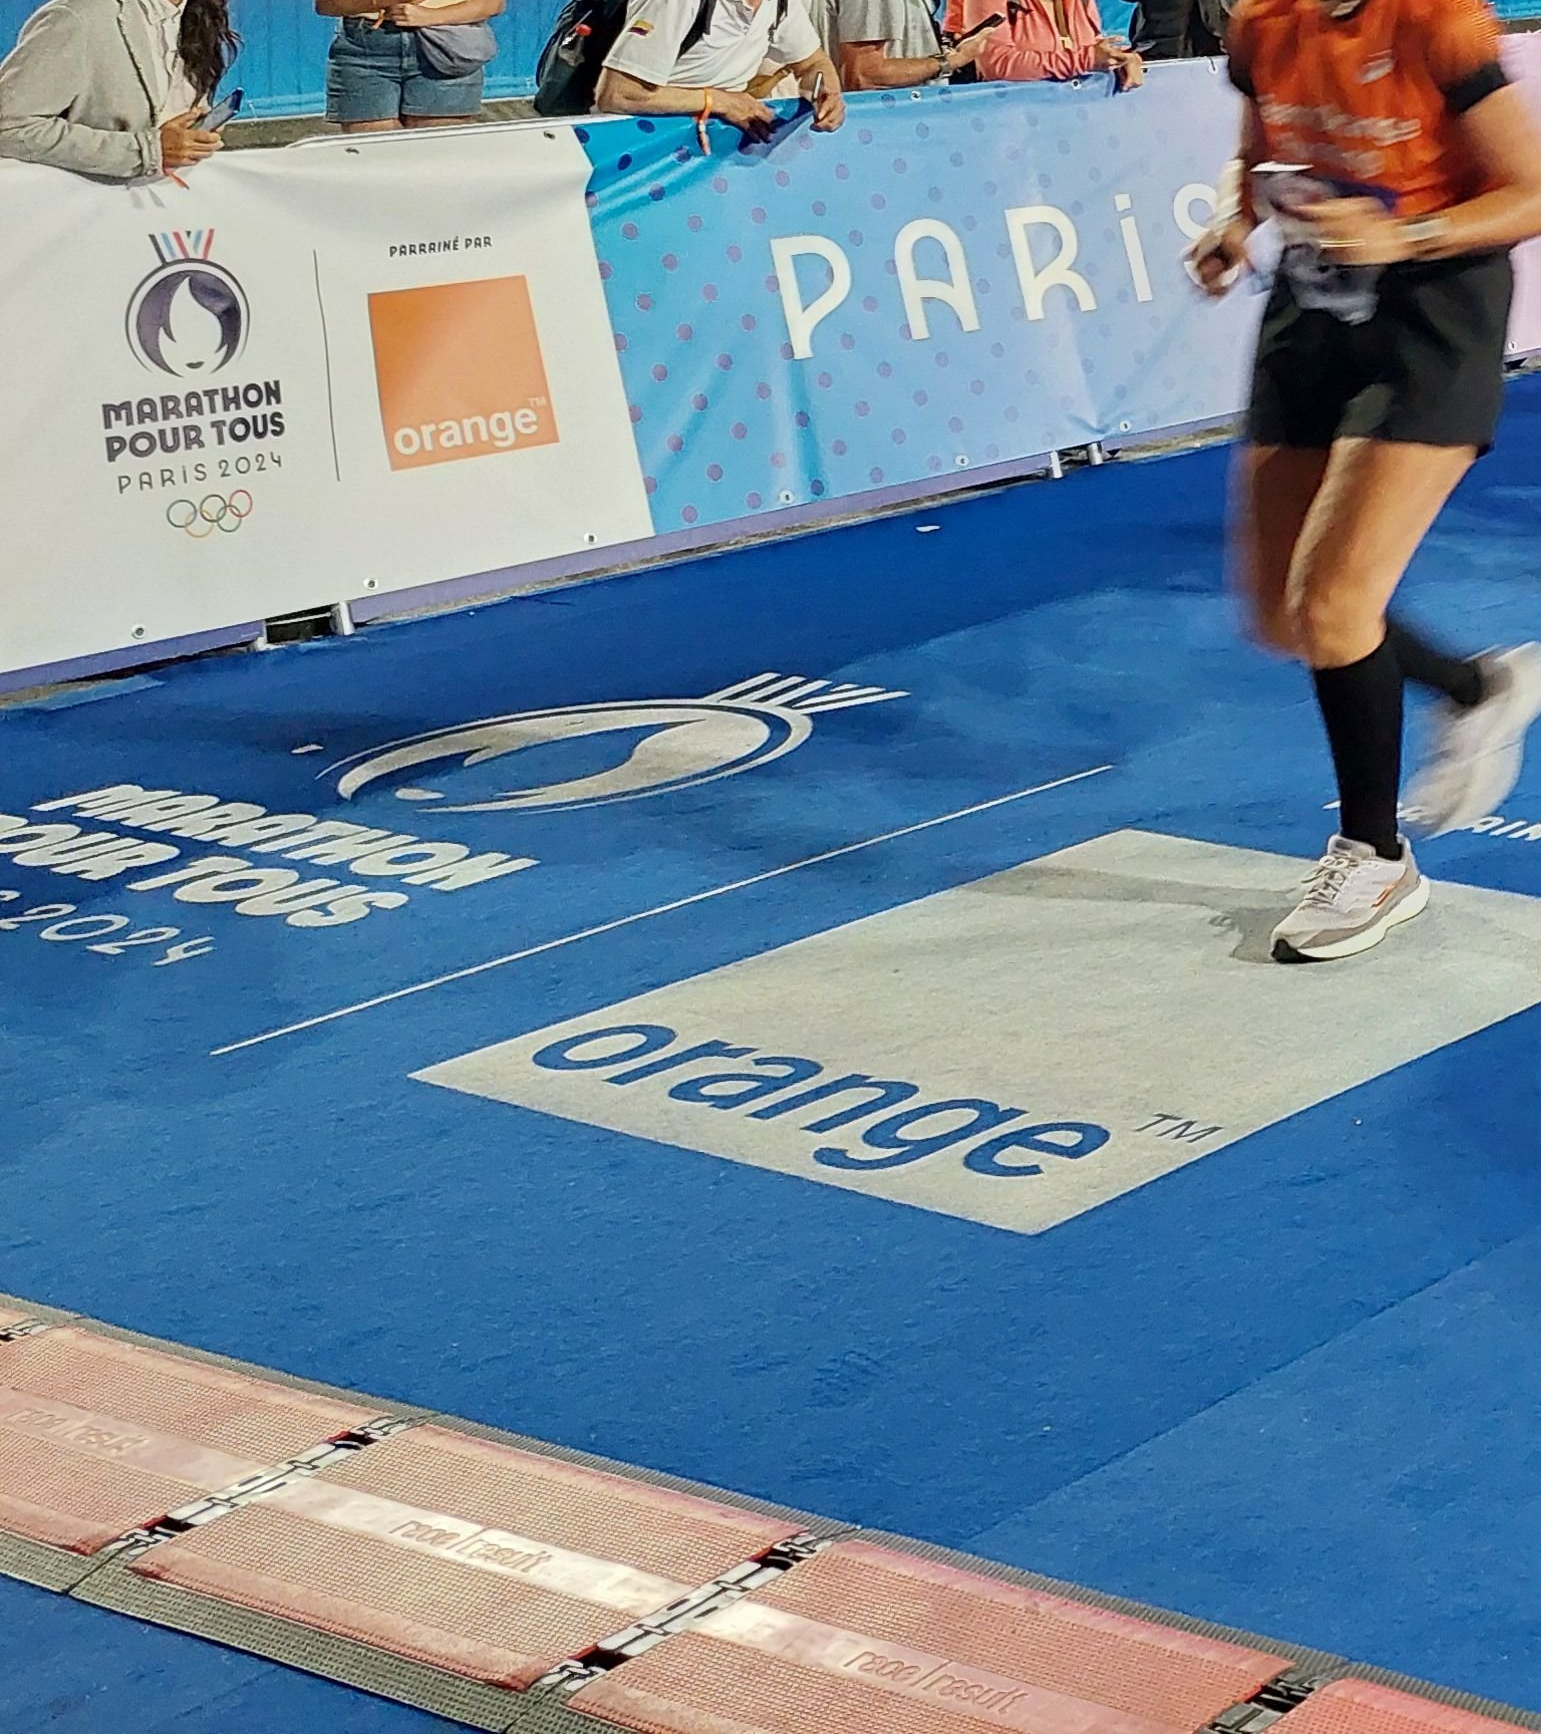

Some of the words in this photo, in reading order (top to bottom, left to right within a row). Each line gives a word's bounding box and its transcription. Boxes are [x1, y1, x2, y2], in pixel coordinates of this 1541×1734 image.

[388, 235, 460, 258] PARRAINÉ
[464, 235, 494, 249] PAR
[102, 379, 283, 431] MARATHON
[393, 404, 539, 456] orange
[105, 416, 206, 463] POUR
[210, 412, 286, 445] TOUS
[218, 450, 284, 479] 2024
[29, 783, 542, 892] MARATHON
[126, 855, 410, 928] TOUS
[0, 903, 217, 966] 2024
[531, 1023, 1111, 1179] orange
